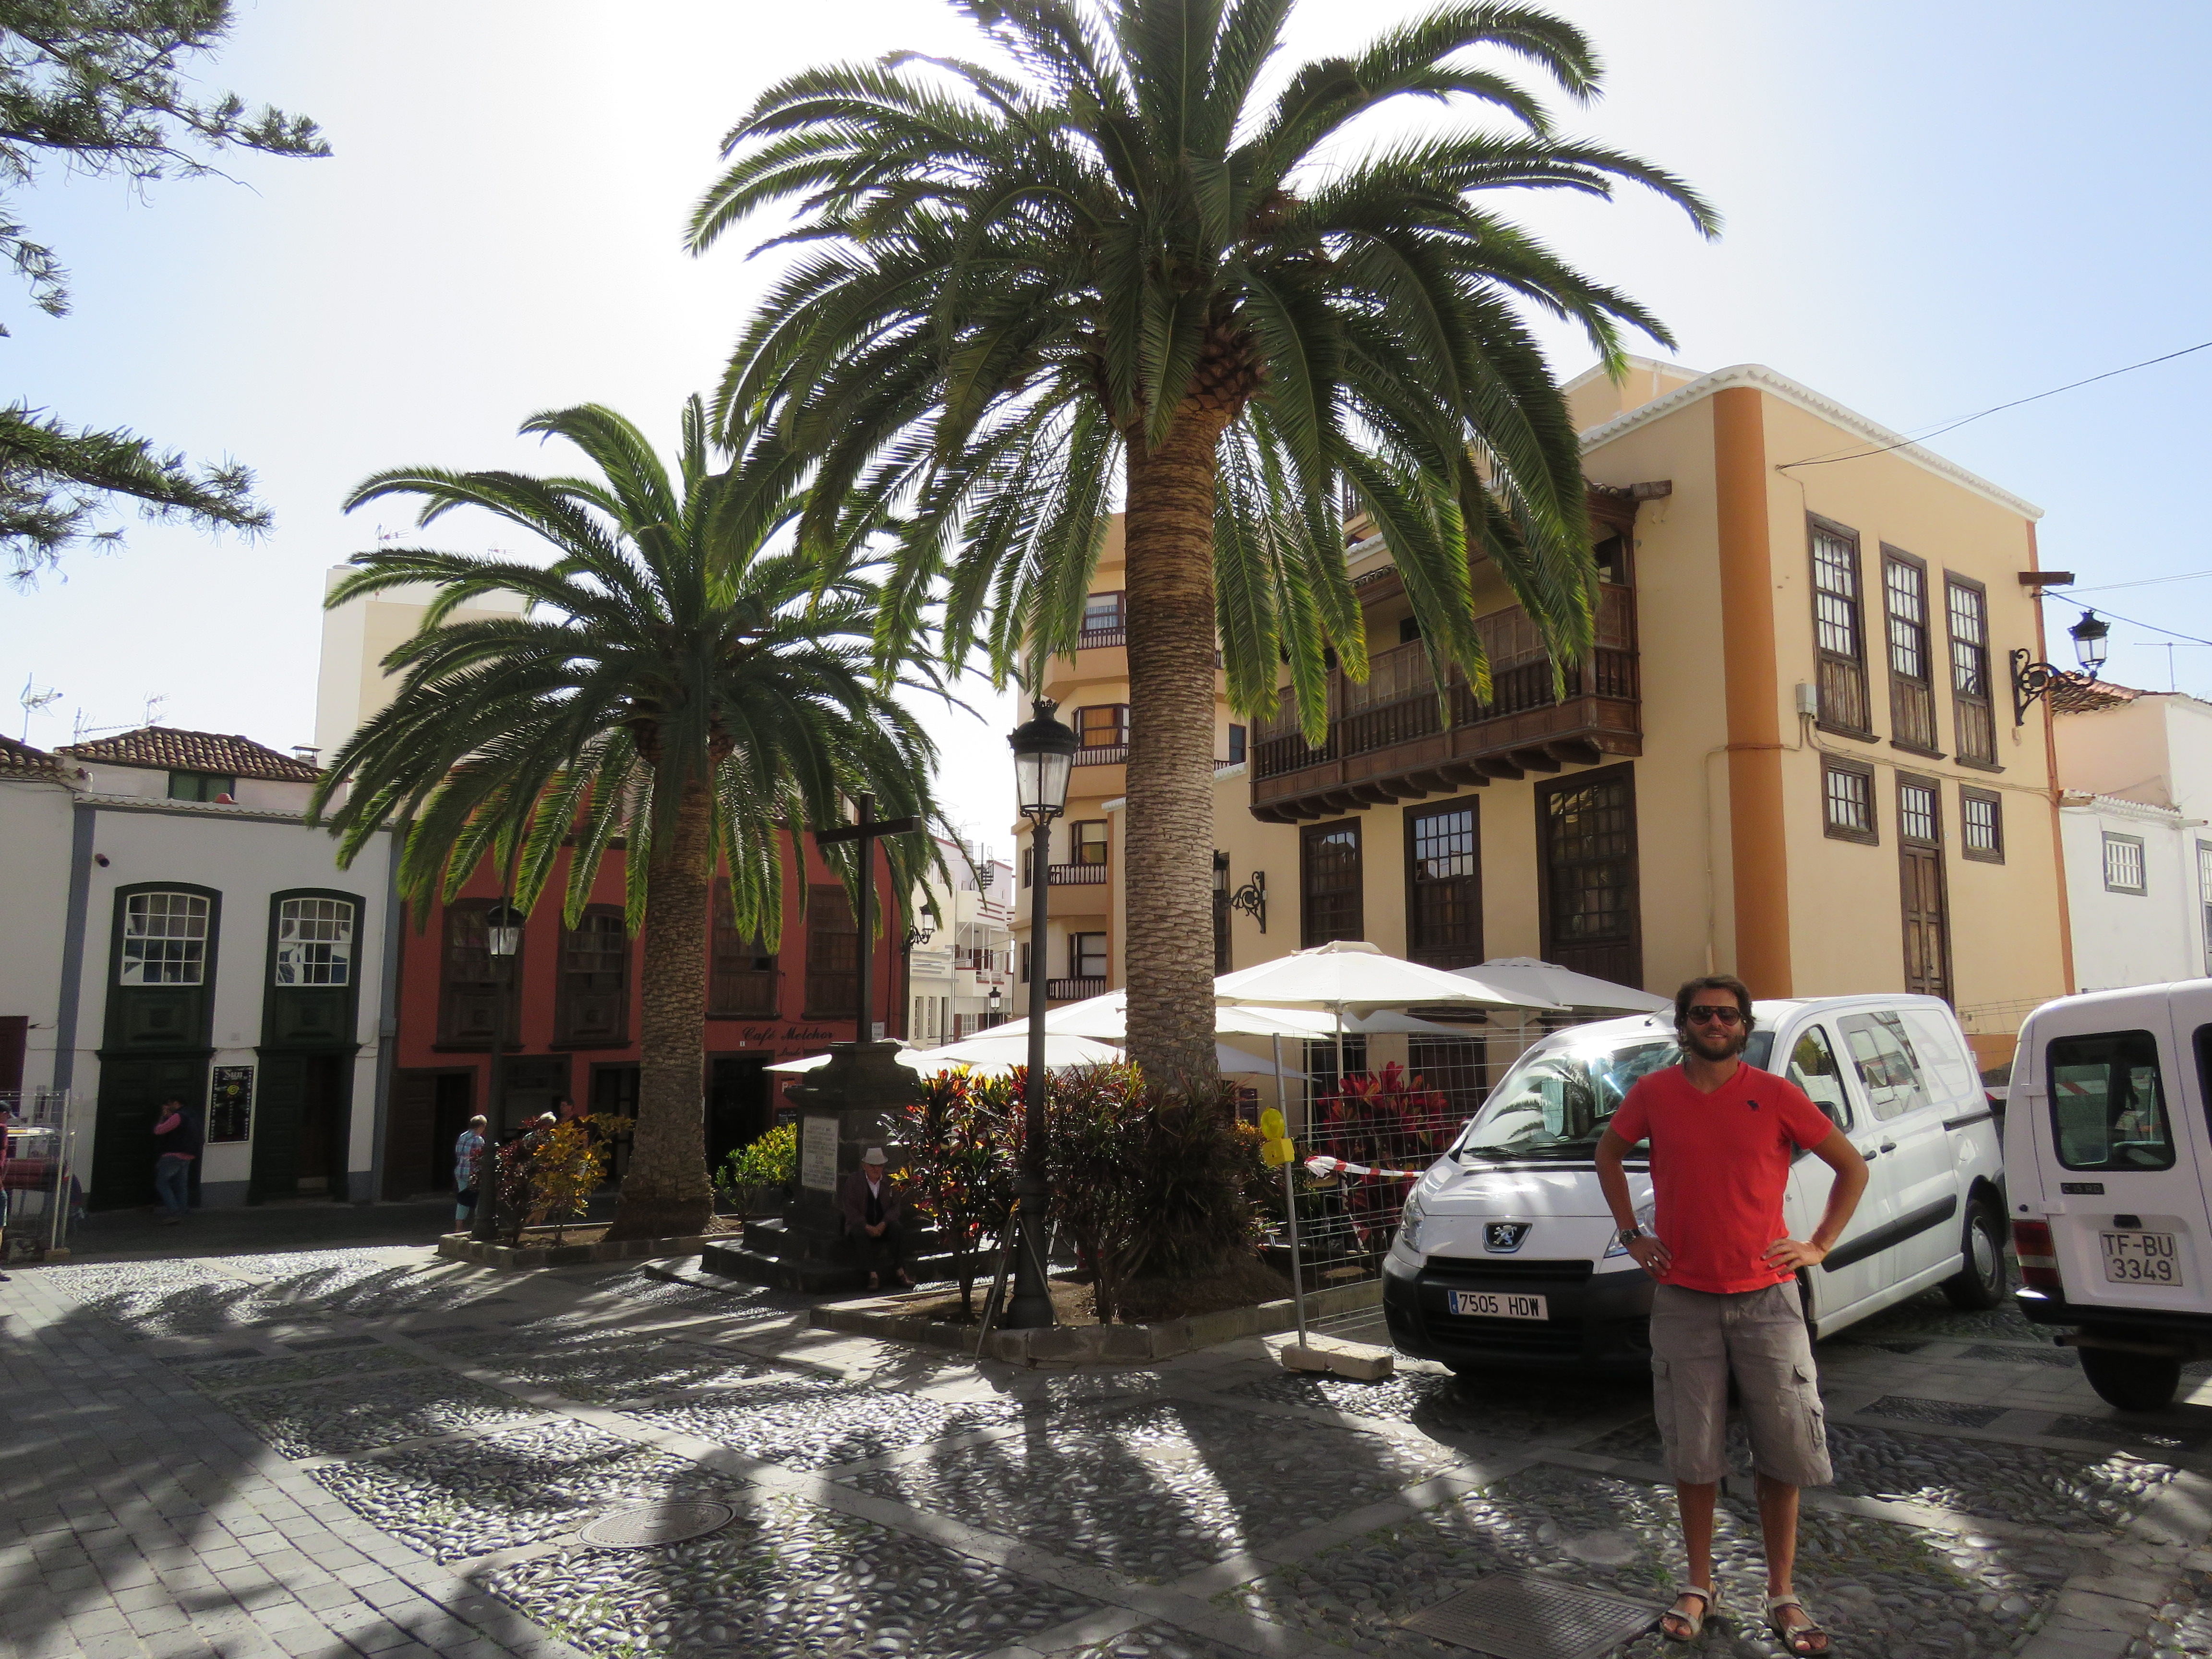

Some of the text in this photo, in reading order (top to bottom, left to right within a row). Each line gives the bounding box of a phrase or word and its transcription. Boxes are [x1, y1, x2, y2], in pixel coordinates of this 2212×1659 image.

[743, 1027, 834, 1046] Café Melchor
[2103, 1234, 2173, 1257] TF-BU
[2113, 1258, 2172, 1281] 3349
[1459, 1294, 1539, 1317] 7505 HDW
